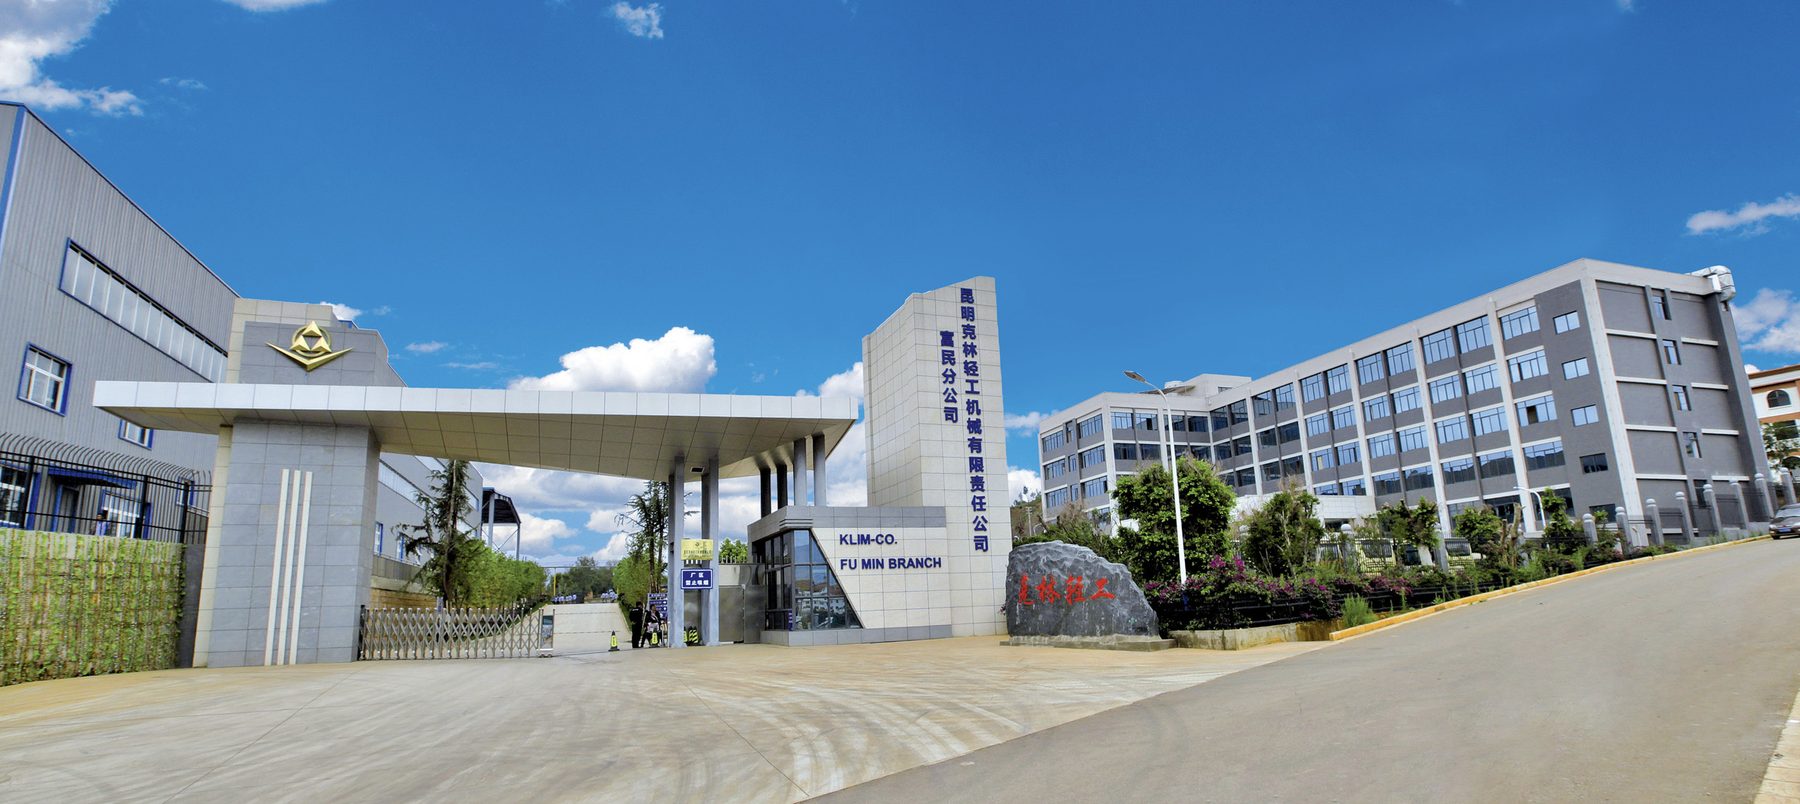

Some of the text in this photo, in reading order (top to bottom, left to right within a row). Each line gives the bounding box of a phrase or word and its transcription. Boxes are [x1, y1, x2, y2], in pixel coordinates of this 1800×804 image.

[940, 330, 958, 424] 富民分公司
[960, 288, 989, 552] 昆明克林轻工机械有限责任公司
[839, 533, 899, 545] KLIM-CO.
[840, 556, 942, 570] FU MIN BRANCH
